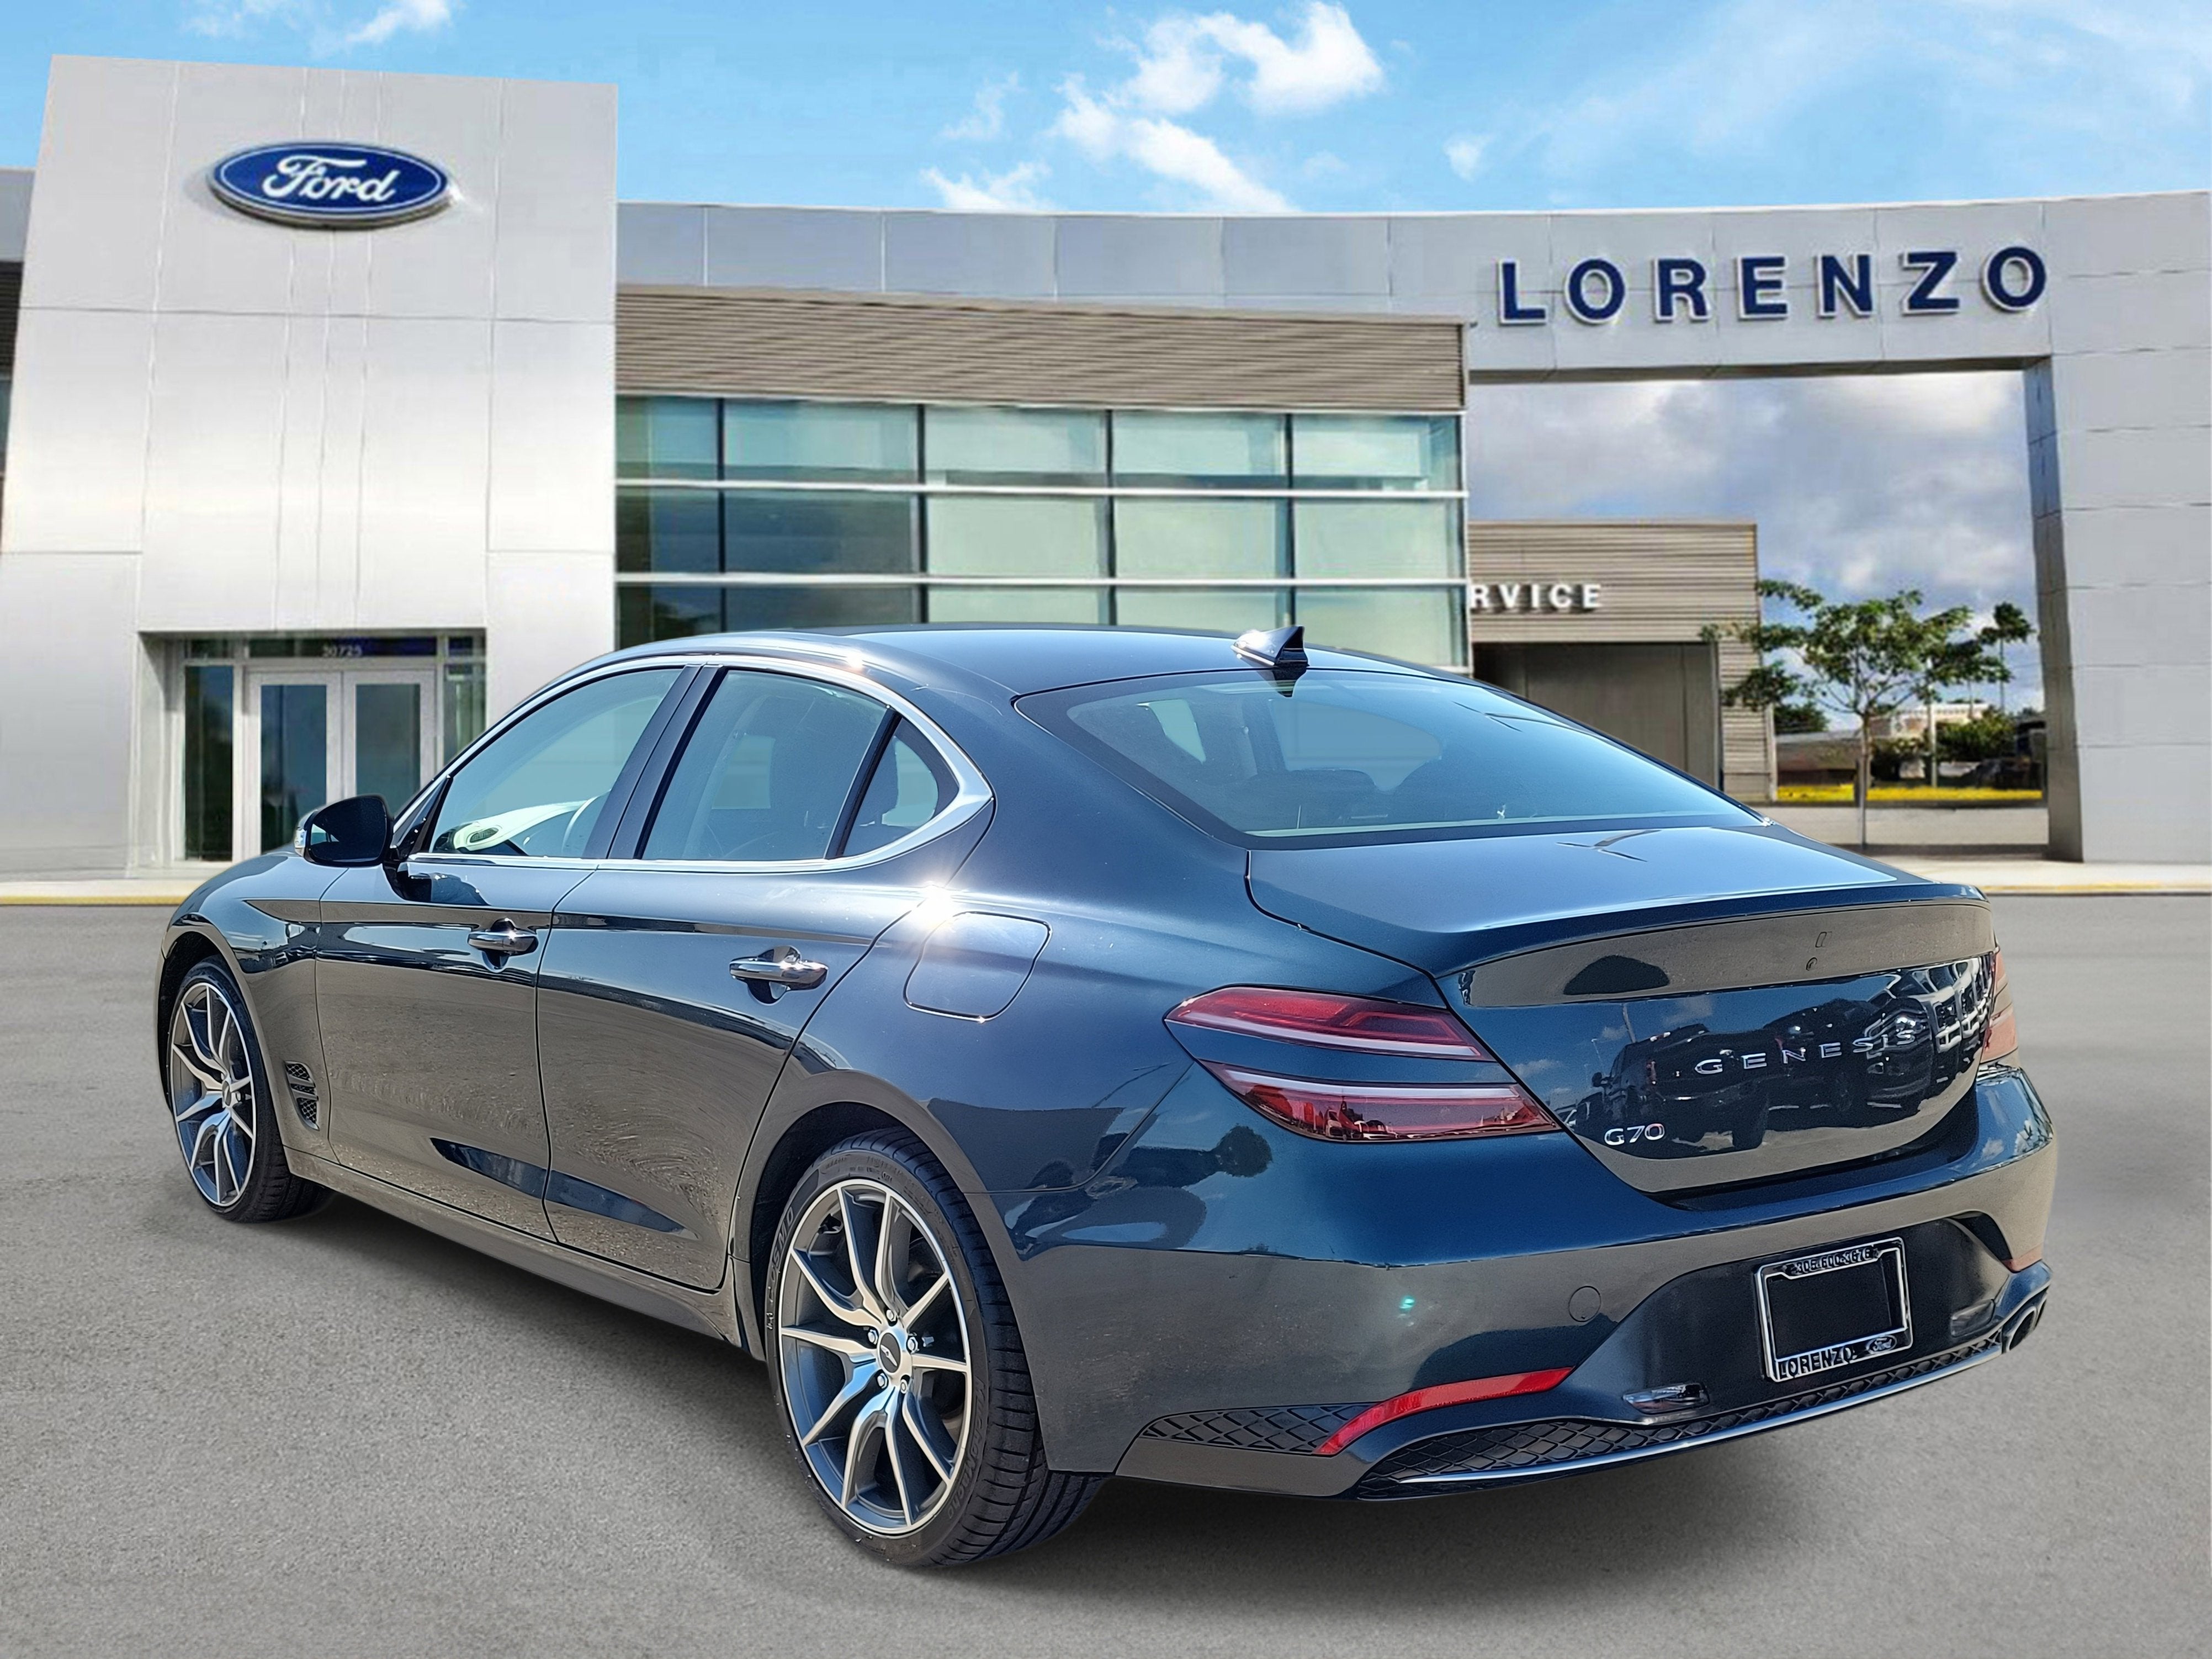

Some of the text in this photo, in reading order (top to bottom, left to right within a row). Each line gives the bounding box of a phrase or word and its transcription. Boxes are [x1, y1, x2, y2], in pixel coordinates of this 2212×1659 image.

[262, 155, 400, 202] Ford
[1498, 246, 2046, 323] LORENZO
[1695, 1030, 1916, 1074] GENESIS
[1604, 1123, 1665, 1146] G70
[1778, 1345, 1856, 1379] LORENZO
